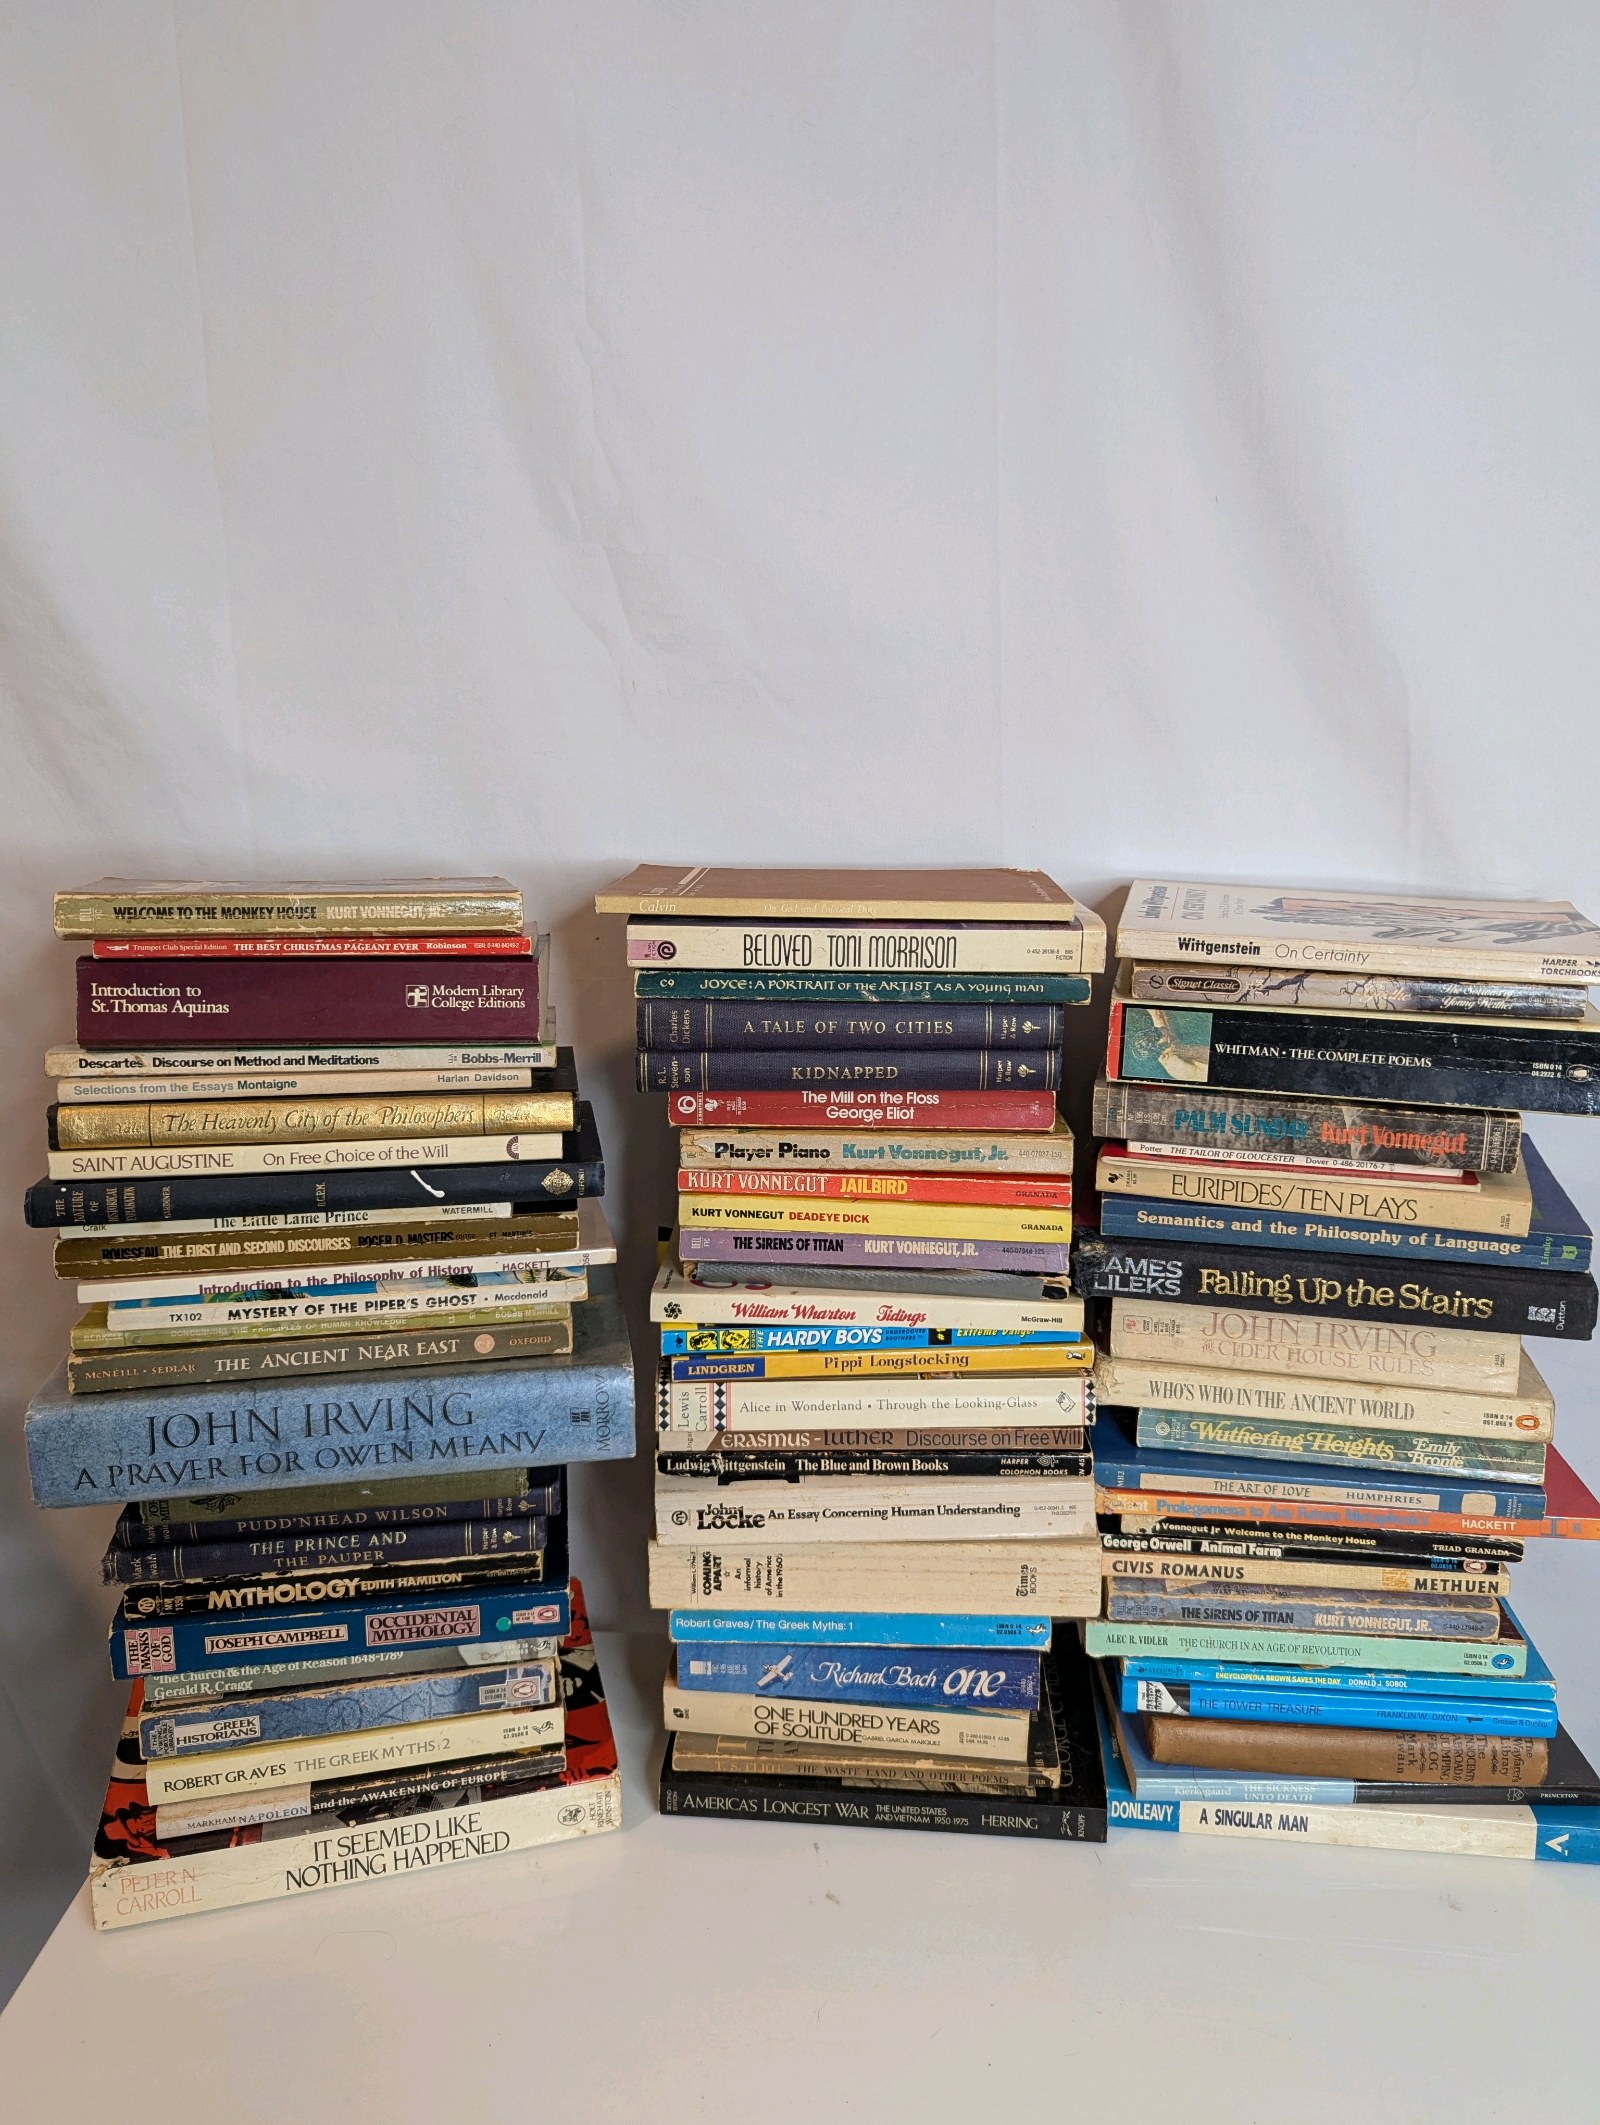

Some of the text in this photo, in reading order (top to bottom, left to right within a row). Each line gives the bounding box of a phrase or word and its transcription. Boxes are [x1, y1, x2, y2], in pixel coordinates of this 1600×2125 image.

[743, 934, 957, 969] BELOVED TONI MORRISON
[1178, 937, 1370, 966] Wittgenstein On Certainty
[91, 983, 201, 997] Introduction to
[432, 985, 524, 999] Modern Library
[91, 999, 230, 1017] St. Thomas Aquinas
[432, 997, 526, 1011] College Editions
[669, 1010, 677, 1043] Charles
[743, 1020, 953, 1034] A TALE OF TWO CITIES
[78, 1054, 380, 1069] Descartes Discourse on Method and Meditations
[1215, 1043, 1432, 1068] WHITMAN THE COMPLETE POEMS
[437, 1072, 519, 1084] Harlan Davidson
[74, 1079, 298, 1096] Selections from the Essays Montaigne
[802, 1091, 939, 1104] The Mill on the Floss
[826, 1106, 915, 1122] George Eliot
[72, 1144, 449, 1173] SAINT AUGUSTINE On Free Choice of the Will
[1140, 1143, 1295, 1163] Potter THE TAILOR OF GLOUCESTER
[692, 1207, 870, 1224] KURT VONNEGUT DEADEYE DICK
[1020, 1223, 1064, 1232] GRANADA
[1136, 1210, 1521, 1254] Semantics and the Philosophy of Language
[1198, 1268, 1493, 1319] Falling Up the Stairs
[169, 1289, 548, 1322] TX102 MYSTERY OF THE PIPER'S GHOST Macdonald
[731, 1302, 926, 1327] William Wharton Tidings
[1020, 1316, 1063, 1324] McGraw-Hill
[1556, 1300, 1566, 1331] Dutton
[767, 1328, 882, 1346] HARDY BOYS
[688, 1363, 755, 1376] LINDGREN
[824, 1354, 970, 1372] Pippi Longstocking
[740, 1399, 862, 1413] Alice in Wonderland
[876, 1396, 1038, 1412] Through the Looking-Glass
[1149, 1380, 1415, 1420] WHO'S WHO IN THE ANCIENT WORLD
[146, 1392, 474, 1457] JOHN IRVING
[73, 1430, 547, 1490] A PRAYER FOR OWEN MEANY
[1214, 1480, 1310, 1498] THE ART OF LOVE
[1346, 1491, 1422, 1505] HUMPHRIES
[1461, 1519, 1516, 1531] HACKETT
[1103, 1535, 1282, 1557] George Orwell Animal Farm
[1112, 1560, 1245, 1579] CIVIS ROMANUS
[1414, 1577, 1500, 1594] METHUEN
[369, 1609, 477, 1630] OCCIDENTAL
[372, 1621, 476, 1642] MYTHOLOGY
[209, 1629, 345, 1653] JOSEPH CAMPBELL
[213, 1718, 256, 1732] GREEK
[754, 1705, 940, 1735] ONE HUNDRED YEARS
[176, 1728, 257, 1745] HISTORIANS
[754, 1721, 863, 1743] OF SOLITUDE
[683, 1794, 869, 1819] AMERICA'S LONGEST WAR
[981, 1815, 1039, 1830] HERRING
[1111, 1801, 1309, 1833] DONLEAVY A SINGULAR MAN
[314, 1812, 482, 1861] IT SEEMED LIKE
[286, 1831, 510, 1890] NOTHING HAPPENED
